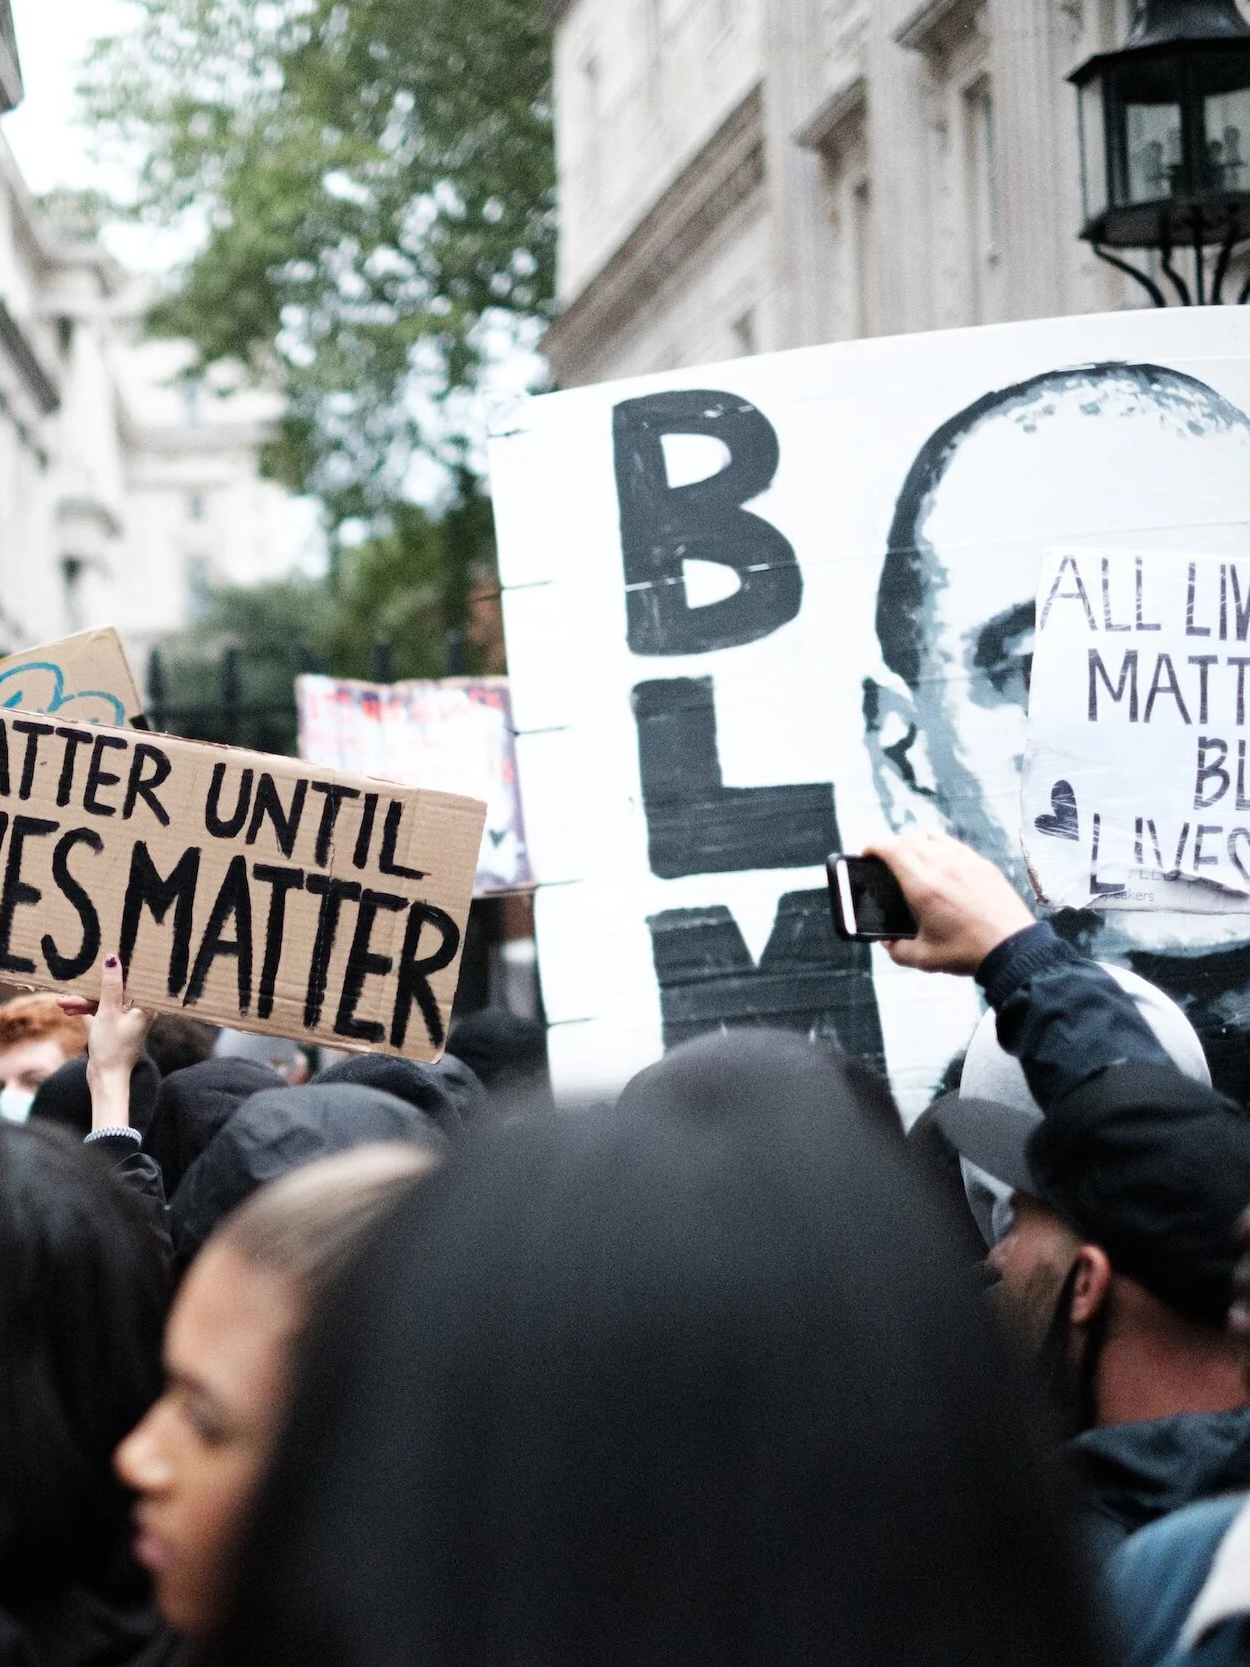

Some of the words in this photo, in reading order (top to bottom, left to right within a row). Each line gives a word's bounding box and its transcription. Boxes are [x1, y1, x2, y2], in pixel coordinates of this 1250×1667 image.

[1040, 556, 1161, 631] ALL
[205, 762, 432, 880] UNTIL
[117, 839, 461, 1049] MATTER
